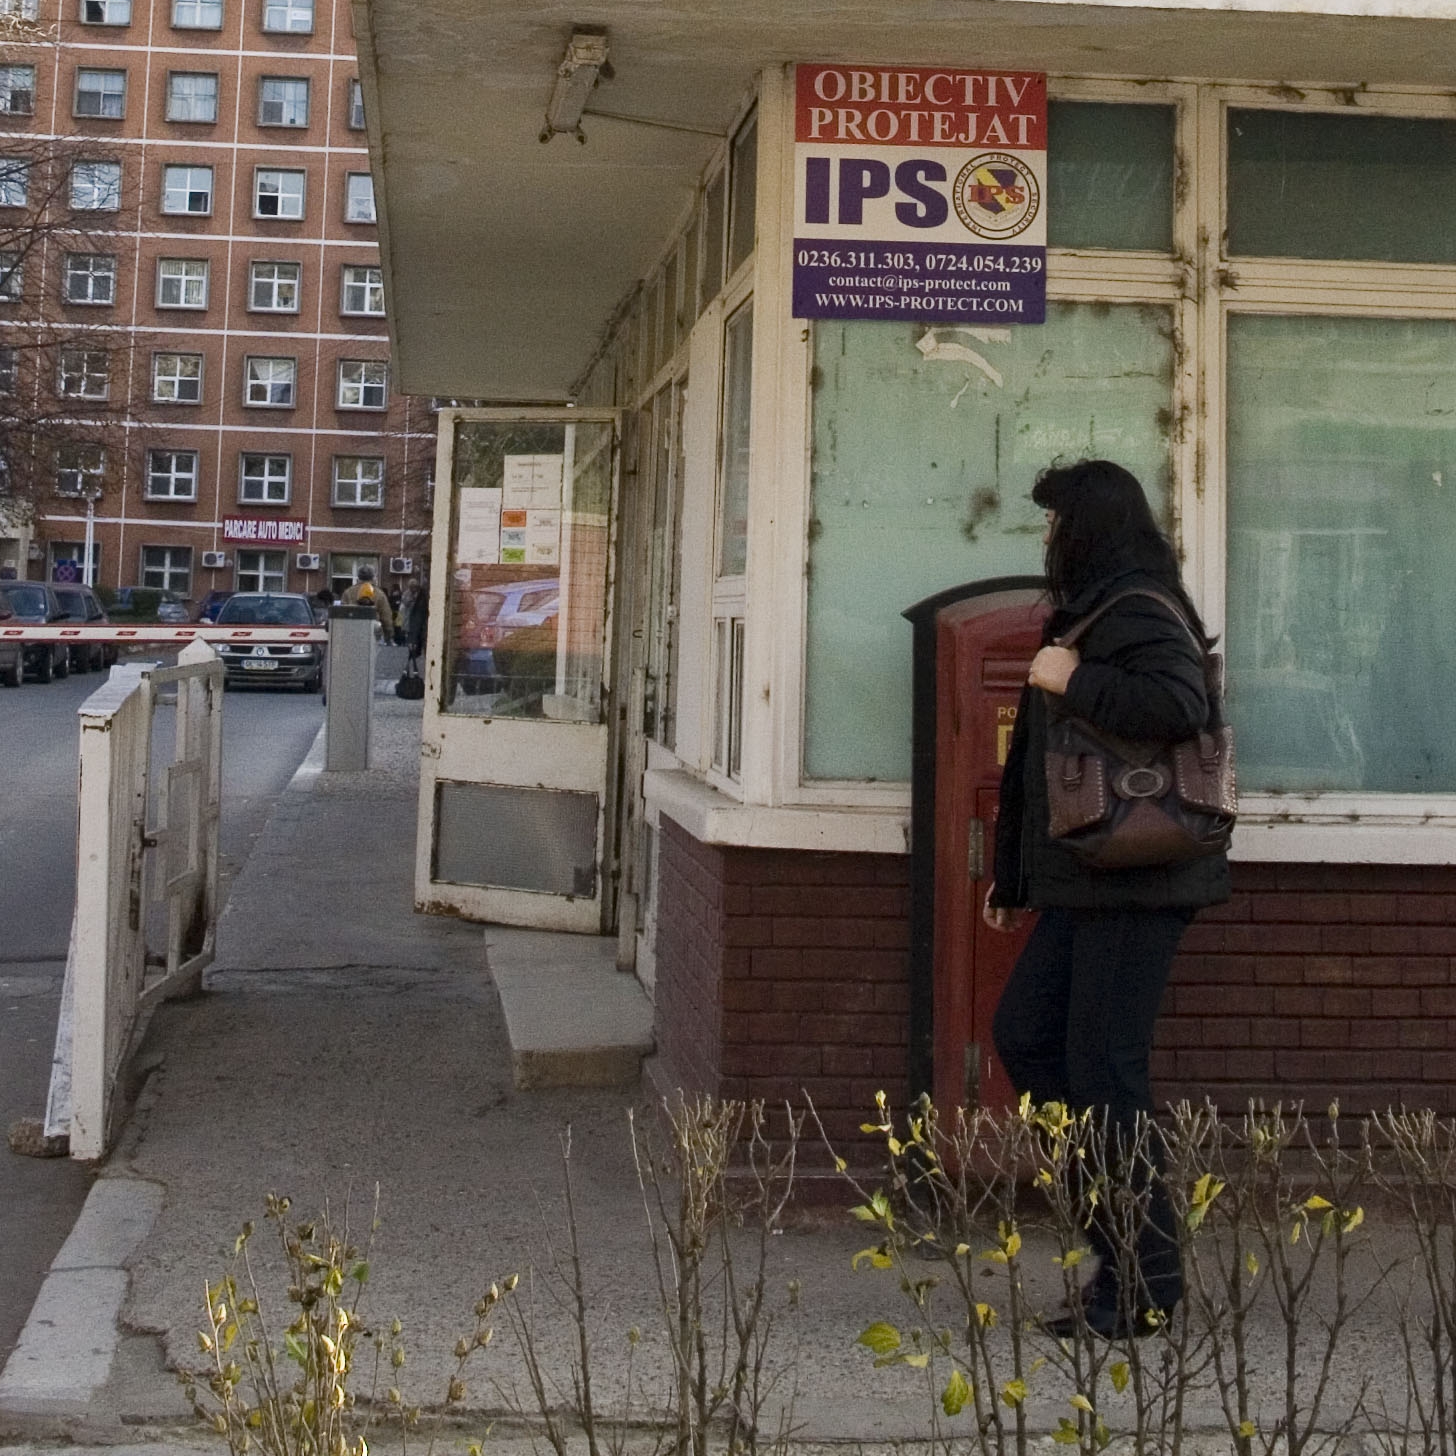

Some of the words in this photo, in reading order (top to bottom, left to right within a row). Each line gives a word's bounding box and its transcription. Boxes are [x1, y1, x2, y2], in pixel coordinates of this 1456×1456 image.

[813, 69, 1031, 108] OBIECTIV
[807, 107, 1038, 146] PROTEJAT
[804, 156, 950, 229] IPS
[968, 184, 1026, 205] IPS
[798, 250, 920, 273] 0236.311.303,
[925, 253, 1043, 274] 0724.054.239
[828, 274, 1012, 292] contact@ips-protect.com
[815, 292, 1025, 314] WWW.IPS-PROTECT.COM
[224, 519, 257, 539] PARCARE
[257, 520, 278, 540] AUTO
[278, 521, 304, 541] MEDICI
